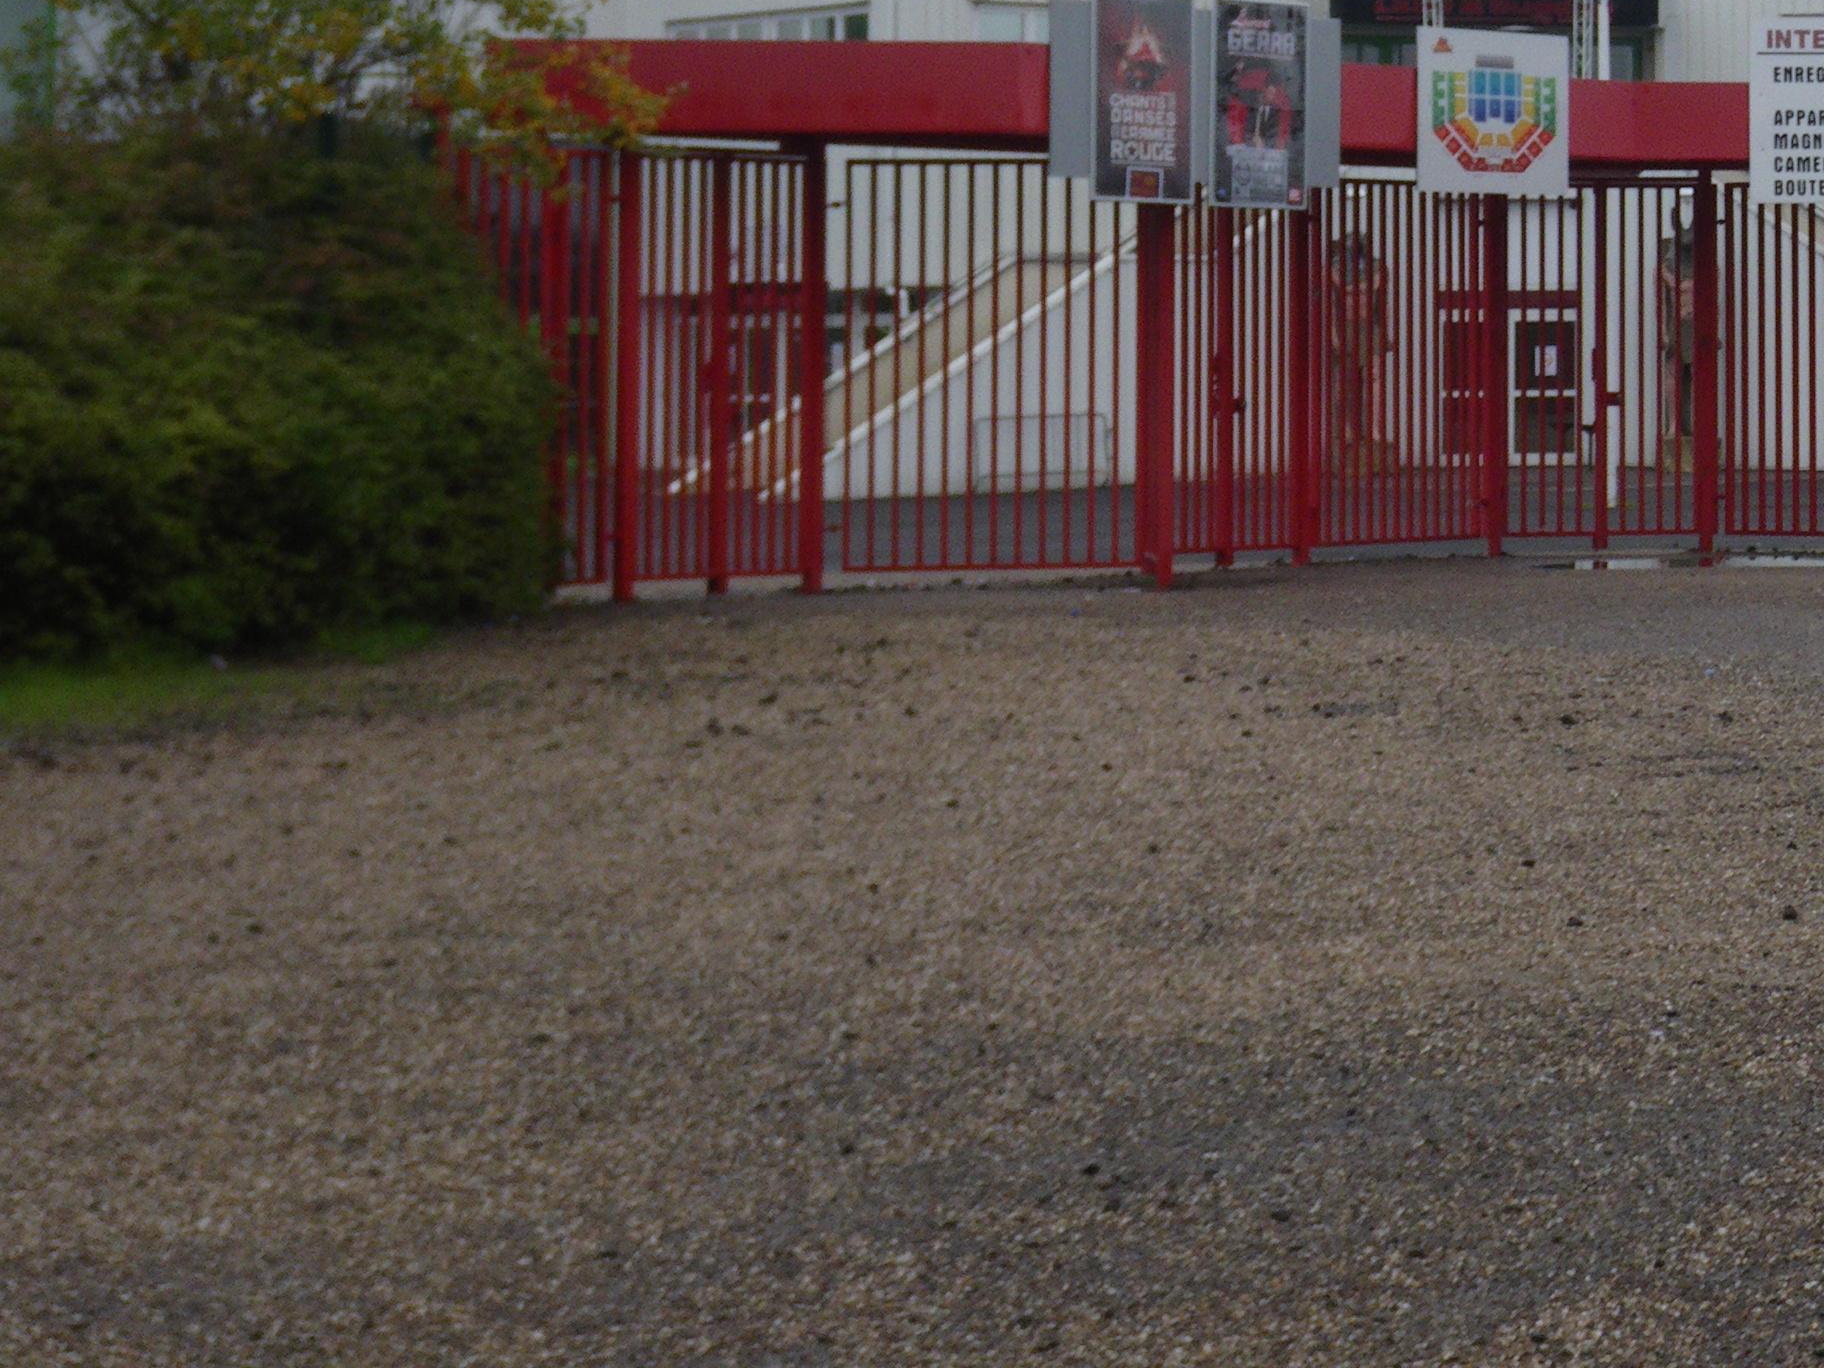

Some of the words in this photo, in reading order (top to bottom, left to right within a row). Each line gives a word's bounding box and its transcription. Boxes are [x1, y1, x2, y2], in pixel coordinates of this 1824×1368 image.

[1227, 28, 1296, 56] GERRA
[1110, 107, 1176, 126] DANSES
[1110, 140, 1176, 161] ROUGE
